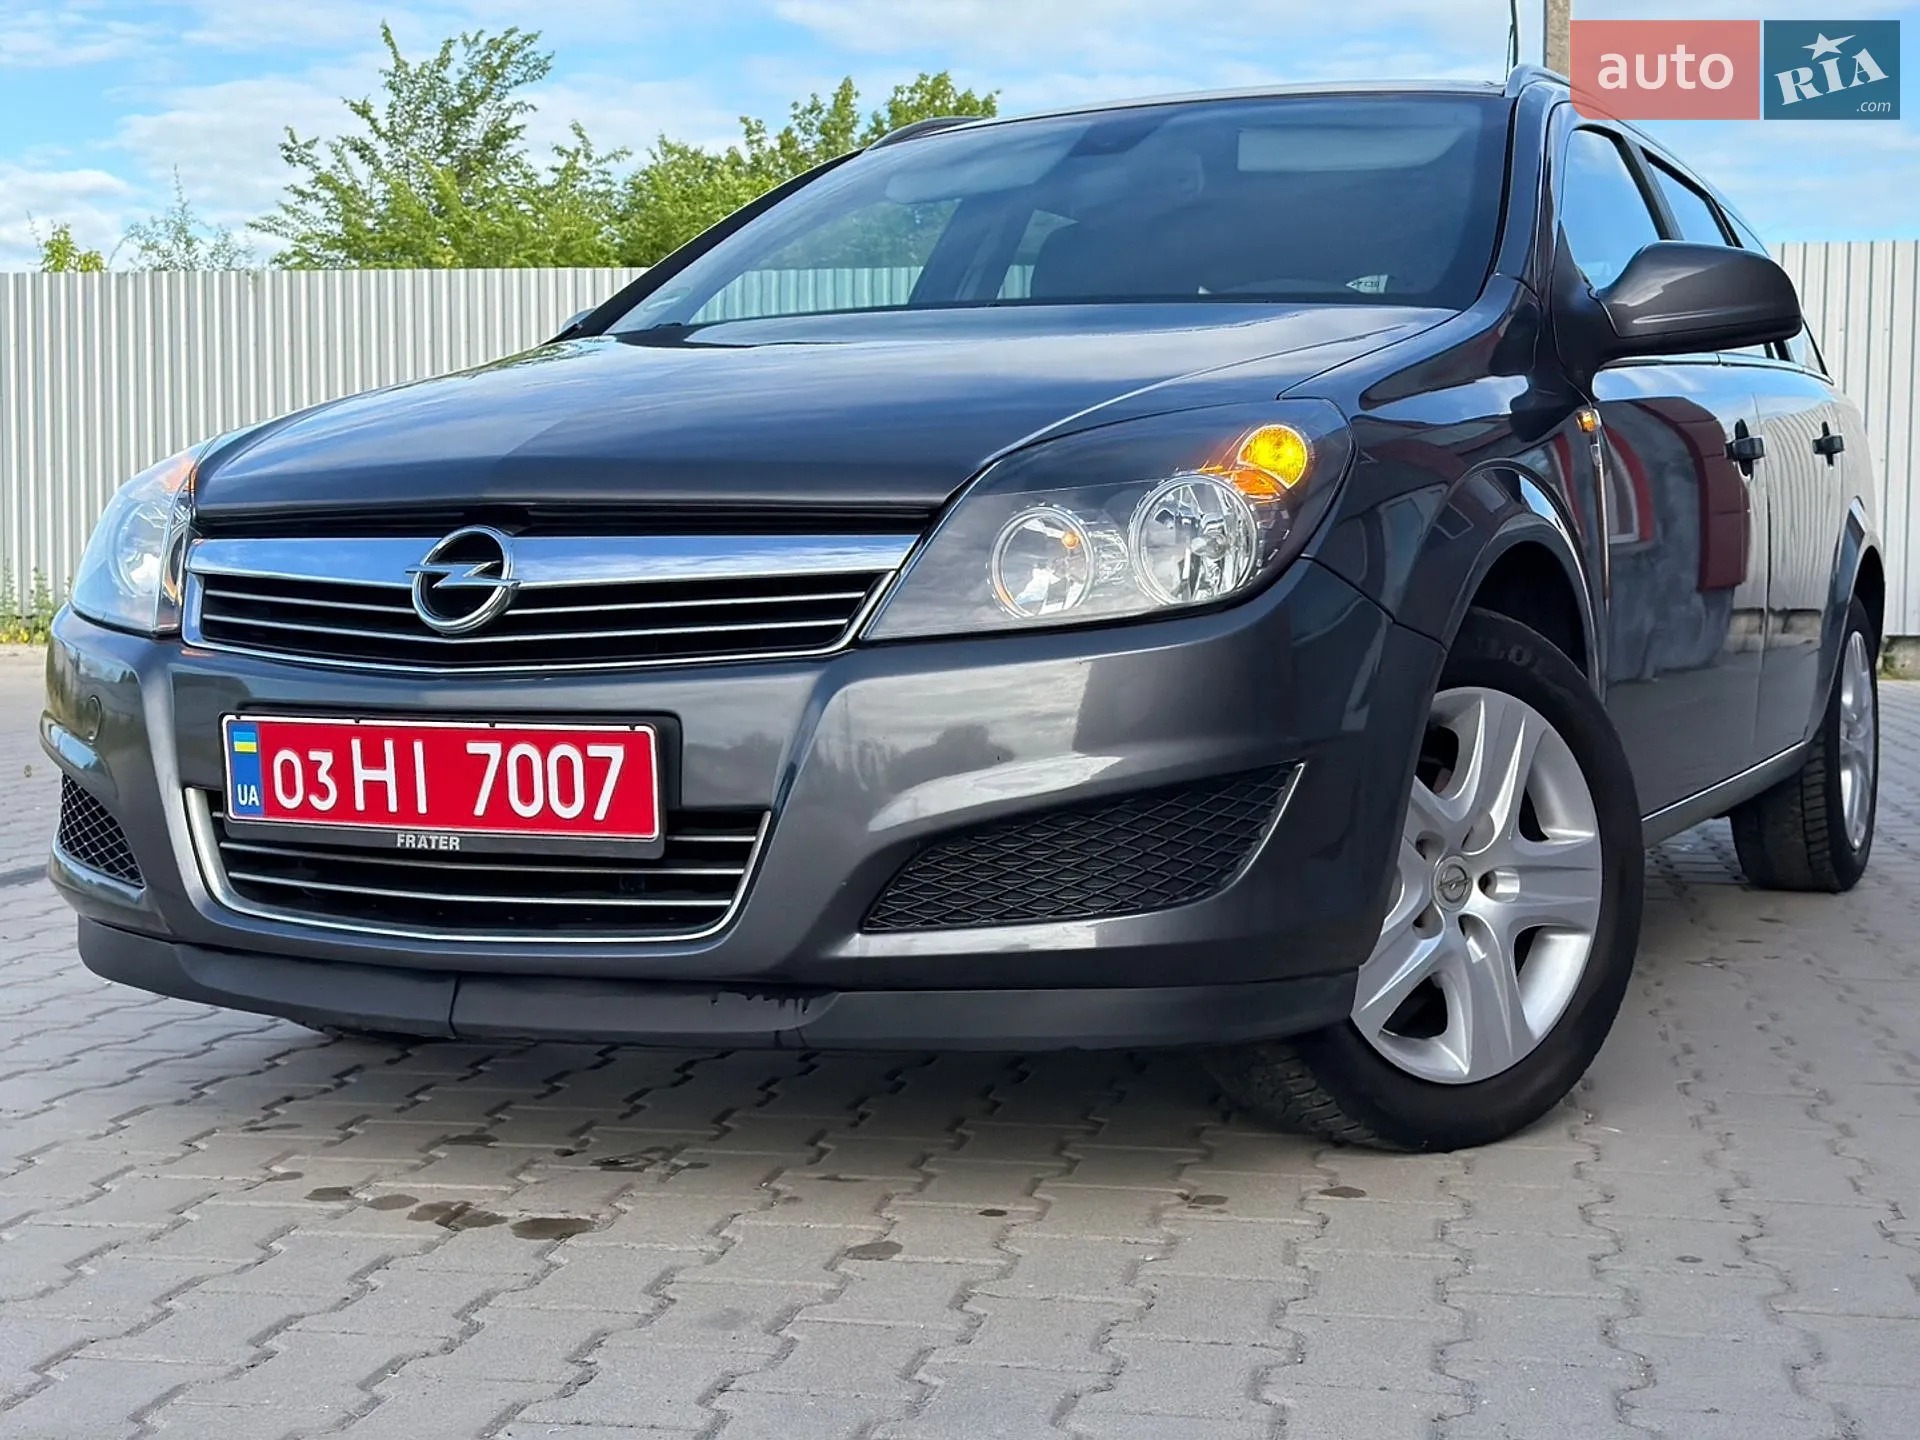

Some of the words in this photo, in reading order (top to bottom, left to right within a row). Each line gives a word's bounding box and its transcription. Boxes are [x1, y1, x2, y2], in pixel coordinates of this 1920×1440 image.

[237, 783, 260, 807] UA
[272, 749, 338, 810] 03
[350, 738, 428, 814] HI
[465, 742, 625, 821] 7007
